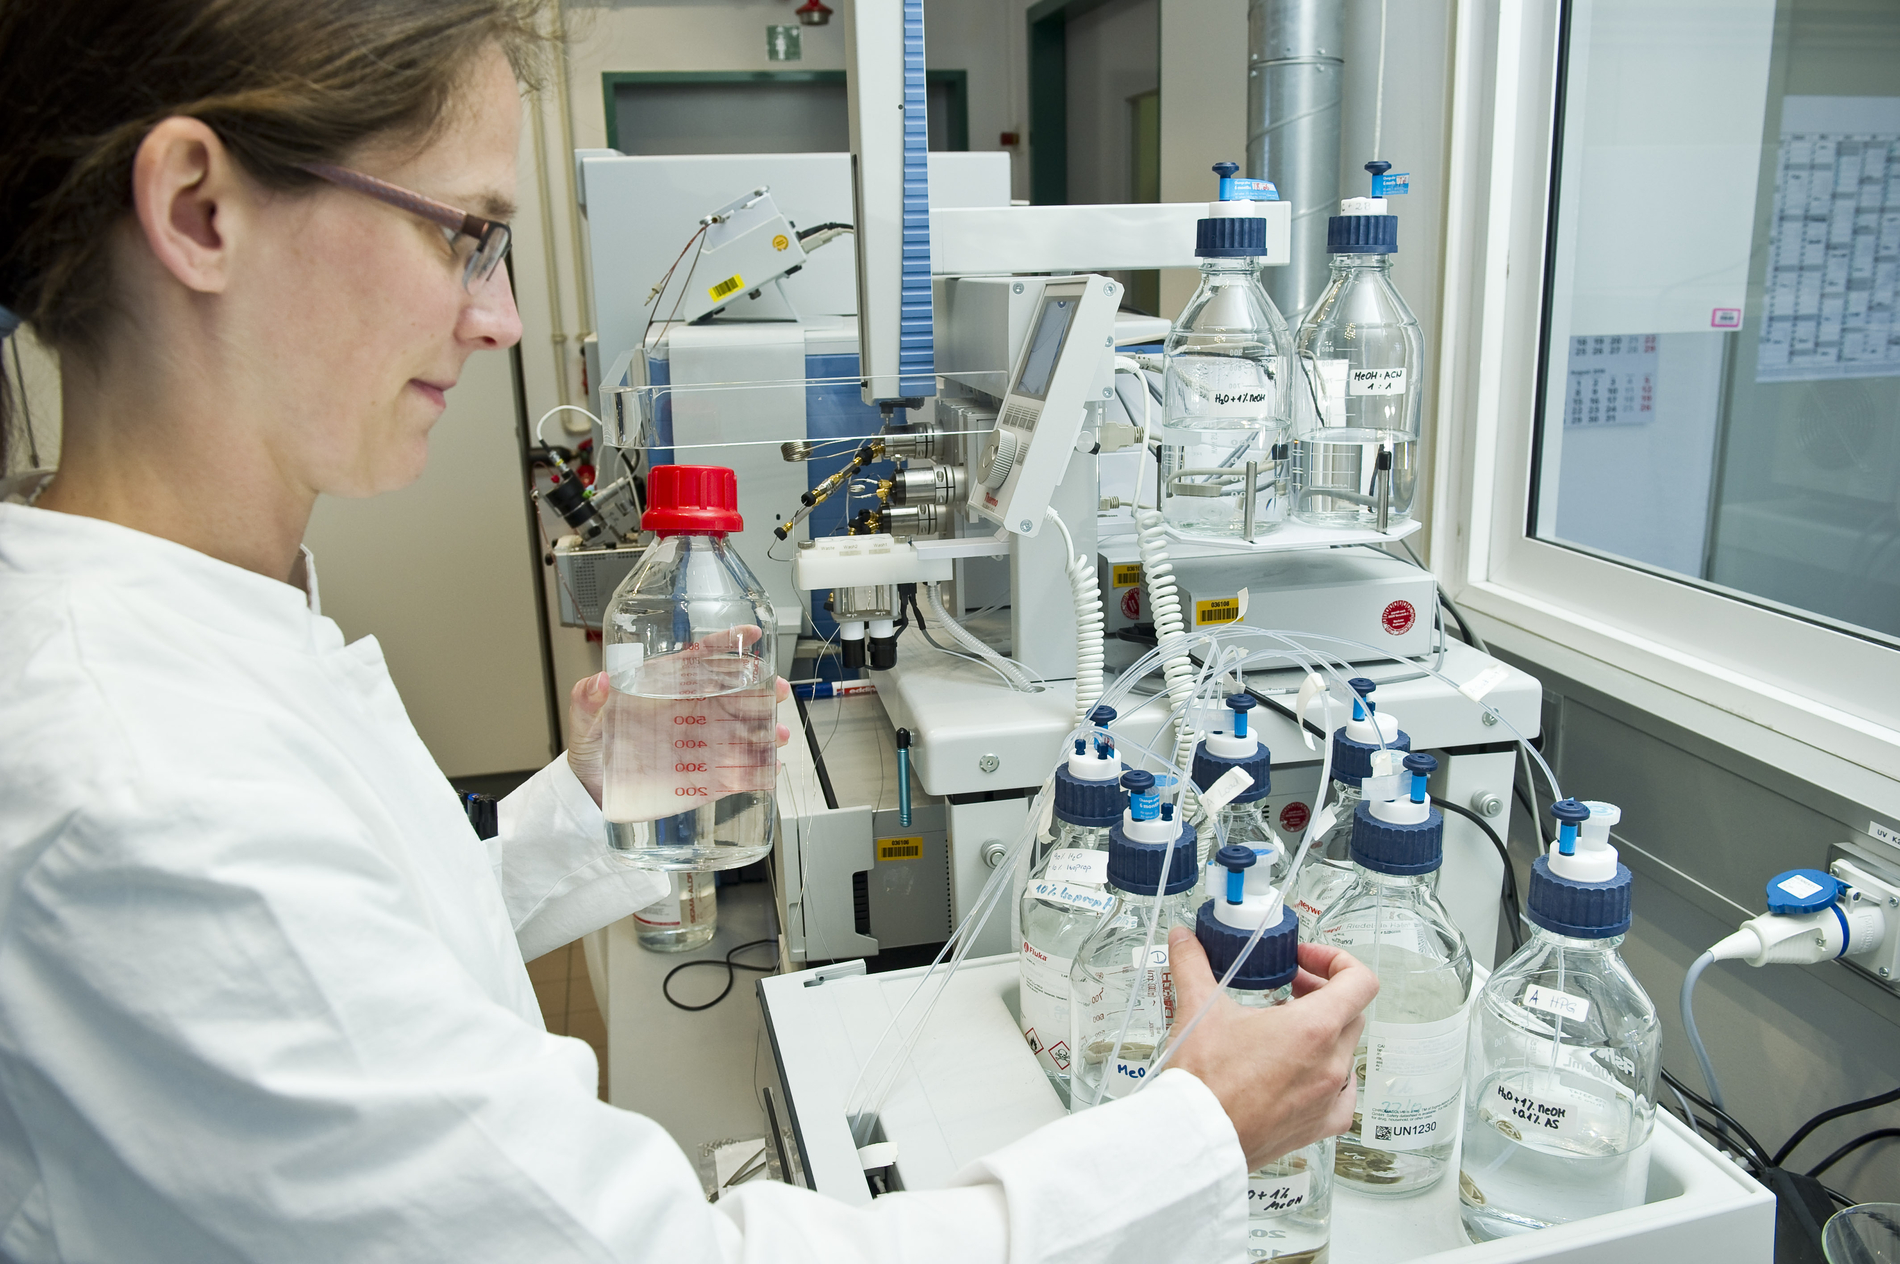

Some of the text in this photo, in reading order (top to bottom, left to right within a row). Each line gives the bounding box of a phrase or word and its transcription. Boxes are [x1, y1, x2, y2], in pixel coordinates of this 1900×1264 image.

[849, 686, 877, 694] eddin
[1877, 829, 1888, 838] UV
[686, 872, 697, 924] SIGMA-ALDR
[1030, 946, 1048, 962] Fluka
[1529, 989, 1539, 1005] A
[1117, 1064, 1147, 1079] MeO
[1393, 1121, 1437, 1137] UN1230
